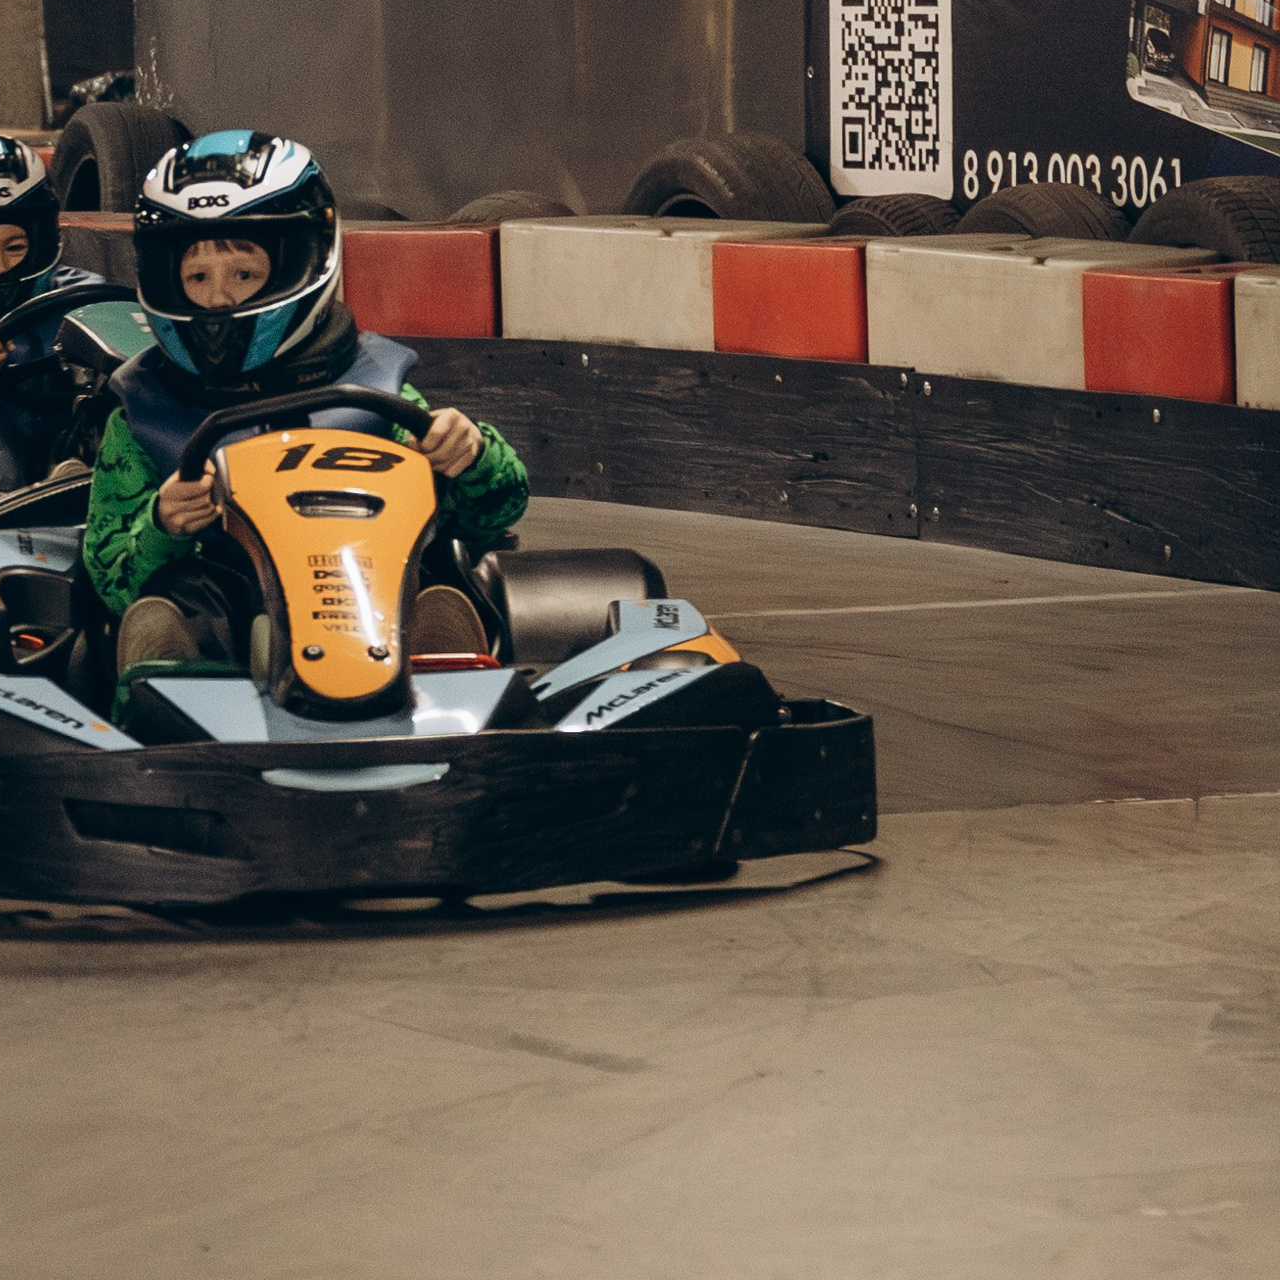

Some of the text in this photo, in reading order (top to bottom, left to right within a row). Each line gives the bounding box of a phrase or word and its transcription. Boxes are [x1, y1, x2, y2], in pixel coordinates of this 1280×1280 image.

[963, 149, 979, 200] 8
[1111, 155, 1182, 208] 3061
[275, 443, 406, 473] 18
